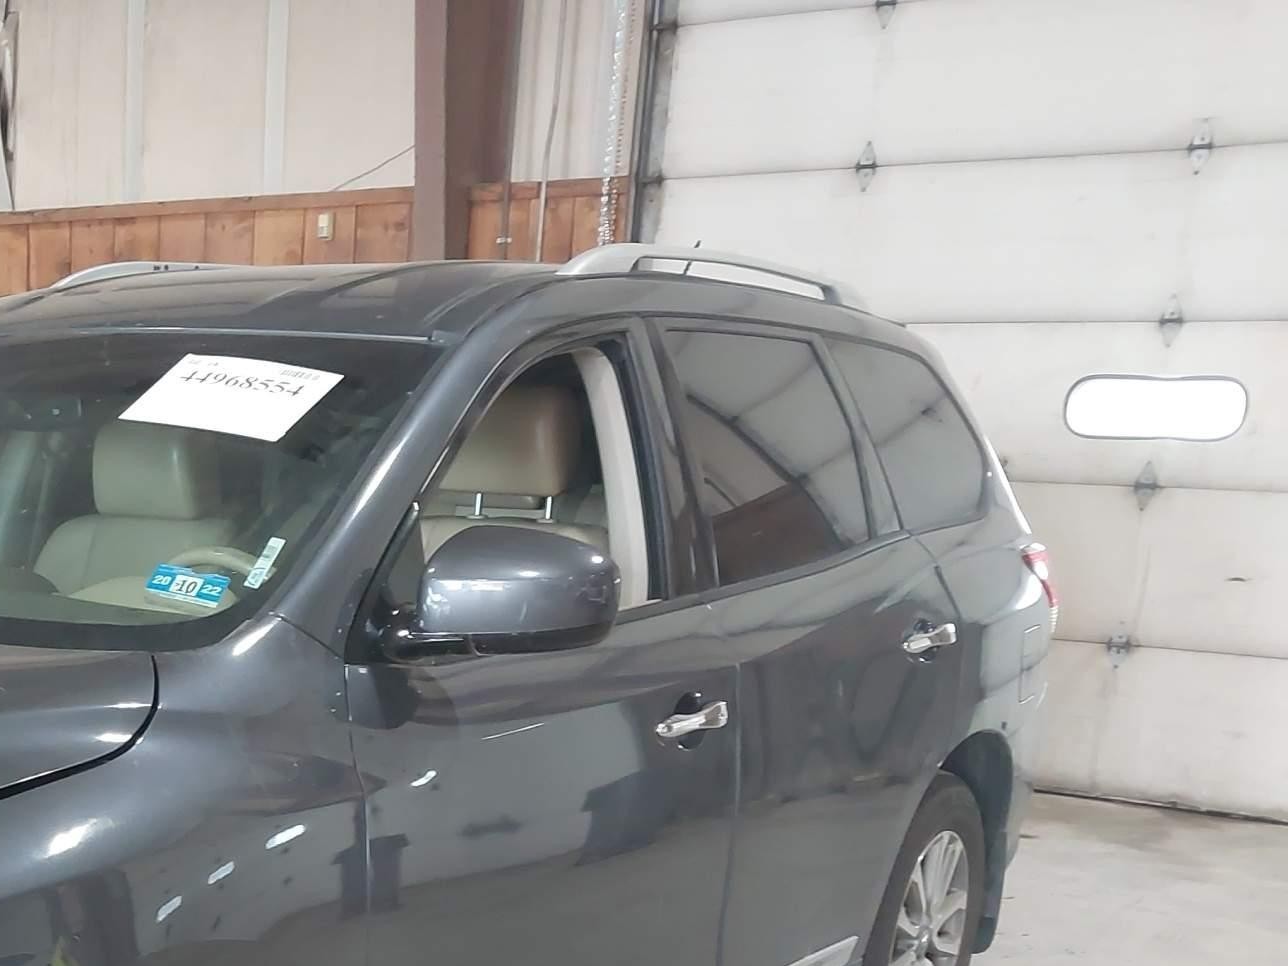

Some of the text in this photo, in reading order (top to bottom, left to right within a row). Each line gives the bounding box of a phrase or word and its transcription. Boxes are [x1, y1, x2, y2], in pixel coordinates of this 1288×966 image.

[179, 370, 305, 397] 44968554
[151, 574, 223, 596] 20 10 22
